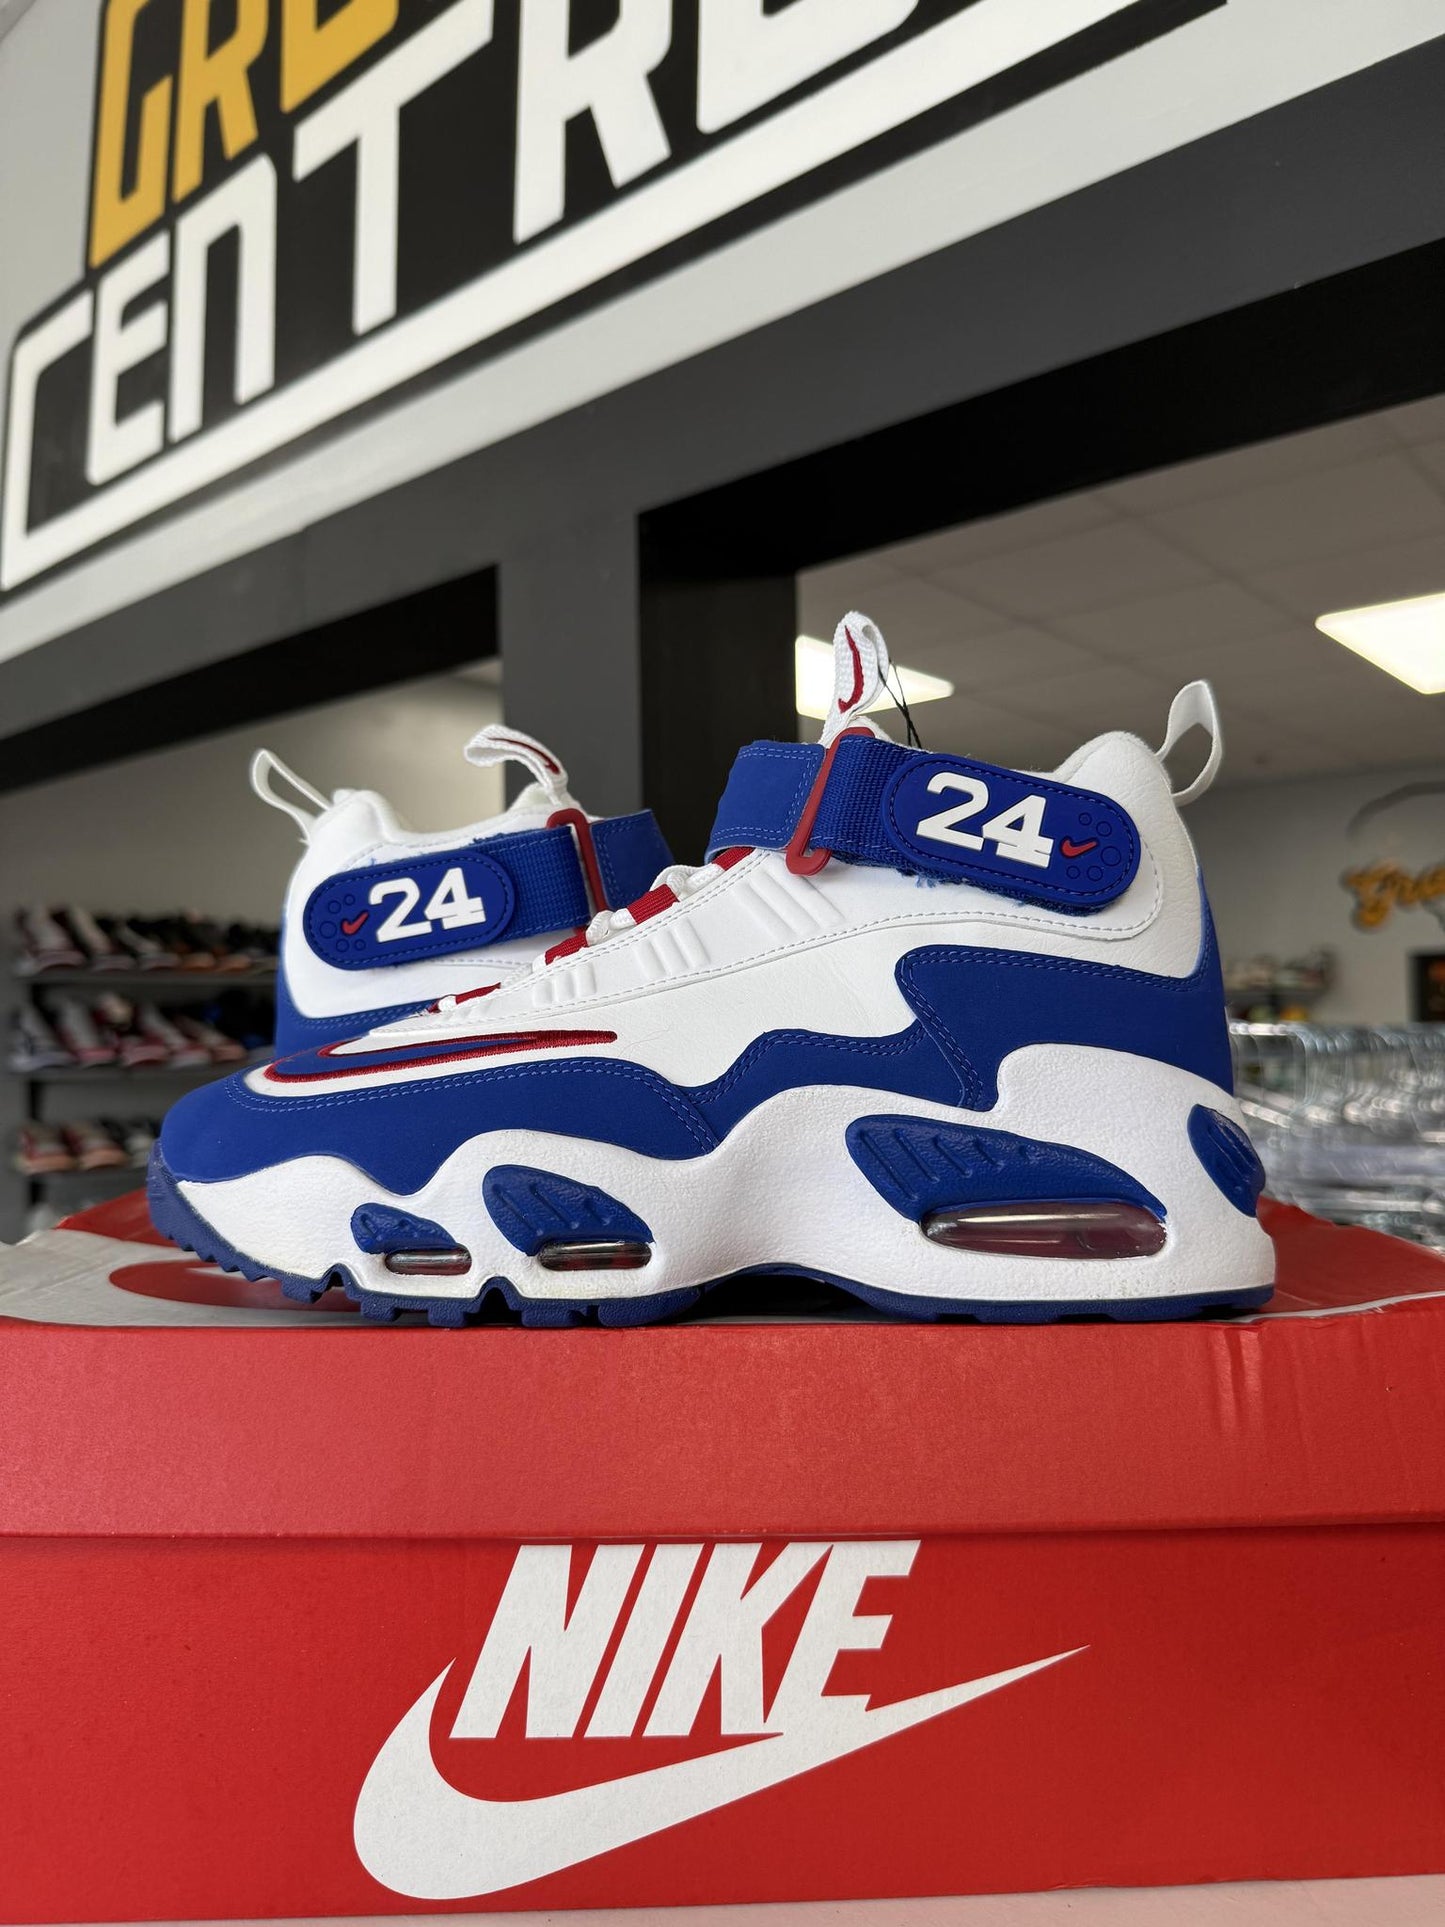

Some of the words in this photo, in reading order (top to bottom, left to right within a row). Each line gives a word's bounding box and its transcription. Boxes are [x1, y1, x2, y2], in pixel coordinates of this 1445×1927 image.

[916, 772, 1054, 868] 24
[368, 867, 486, 943] 24
[449, 1539, 921, 1738] NIKE
